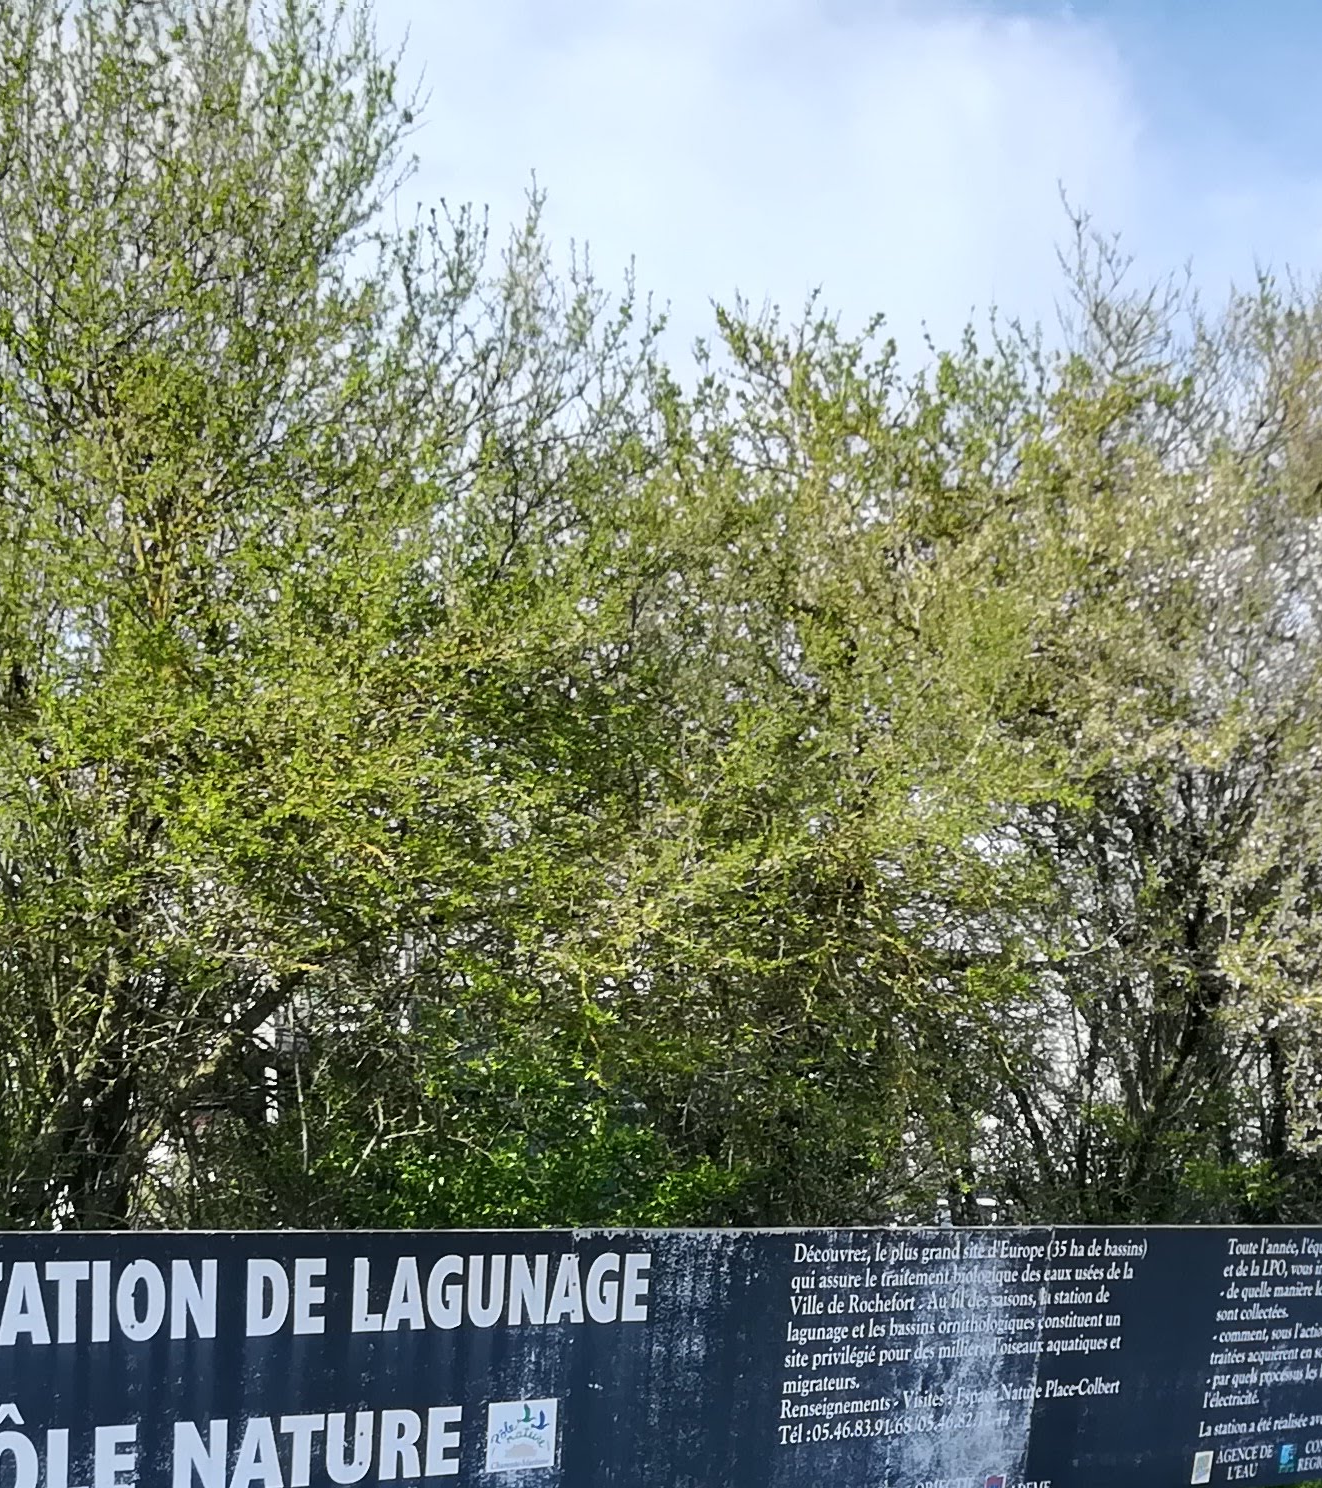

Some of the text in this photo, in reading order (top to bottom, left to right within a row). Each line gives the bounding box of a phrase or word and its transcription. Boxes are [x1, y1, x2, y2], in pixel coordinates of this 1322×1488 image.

[794, 1239, 1148, 1265] Découvrez, le plus grand site d'Europe (35 ha de bassins)
[1228, 1238, 1258, 1255] Toute
[1260, 1237, 1299, 1257] l'année,
[791, 1261, 1134, 1294] qui assure le traitement biologique des eaux usées de la
[1223, 1264, 1234, 1277] et
[1236, 1260, 1248, 1276] de
[1250, 1259, 1260, 1276] la
[1262, 1259, 1288, 1278] LPO,
[1291, 1264, 1313, 1275] vous
[246, 1257, 327, 1337] DE
[351, 1253, 652, 1333] LAGUNAGE
[790, 1295, 824, 1316] Ville
[827, 1294, 845, 1314] de
[848, 1292, 915, 1313] Rochefort
[927, 1290, 947, 1310] Au
[968, 1288, 988, 1308] des
[991, 1289, 1036, 1308] saisons,
[1039, 1287, 1051, 1305] la
[1054, 1287, 1093, 1304] station
[1095, 1285, 1110, 1303] de
[1226, 1282, 1239, 1299] de
[1241, 1281, 1272, 1302] quelle
[1273, 1281, 1313, 1298] manière
[1216, 1303, 1289, 1321] sont collectées.
[787, 1311, 1120, 1345] lagunage et les bassins ornithologiques constituent un
[1219, 1328, 1269, 1343] comment,
[1271, 1327, 1292, 1340] sous
[784, 1334, 1121, 1370] site privilégié pour des milliers d'oiseaux aquatiques et
[1210, 1348, 1246, 1365] traitées
[1300, 1349, 1312, 1360] en
[782, 1375, 860, 1397] migrateurs.
[1212, 1374, 1230, 1390] par
[1232, 1367, 1258, 1388] quels
[1305, 1363, 1318, 1380] les
[780, 1398, 891, 1419] Renseignements
[1001, 1383, 1042, 1400] Nature
[1199, 1421, 1212, 1438] La
[1214, 1419, 1247, 1436] station
[1248, 1424, 1255, 1432] a
[1257, 1416, 1272, 1432] été
[1274, 1412, 1308, 1430] réalisée
[1216, 1445, 1274, 1464] AGENCE DE
[1227, 1463, 1259, 1480] L'EAU
